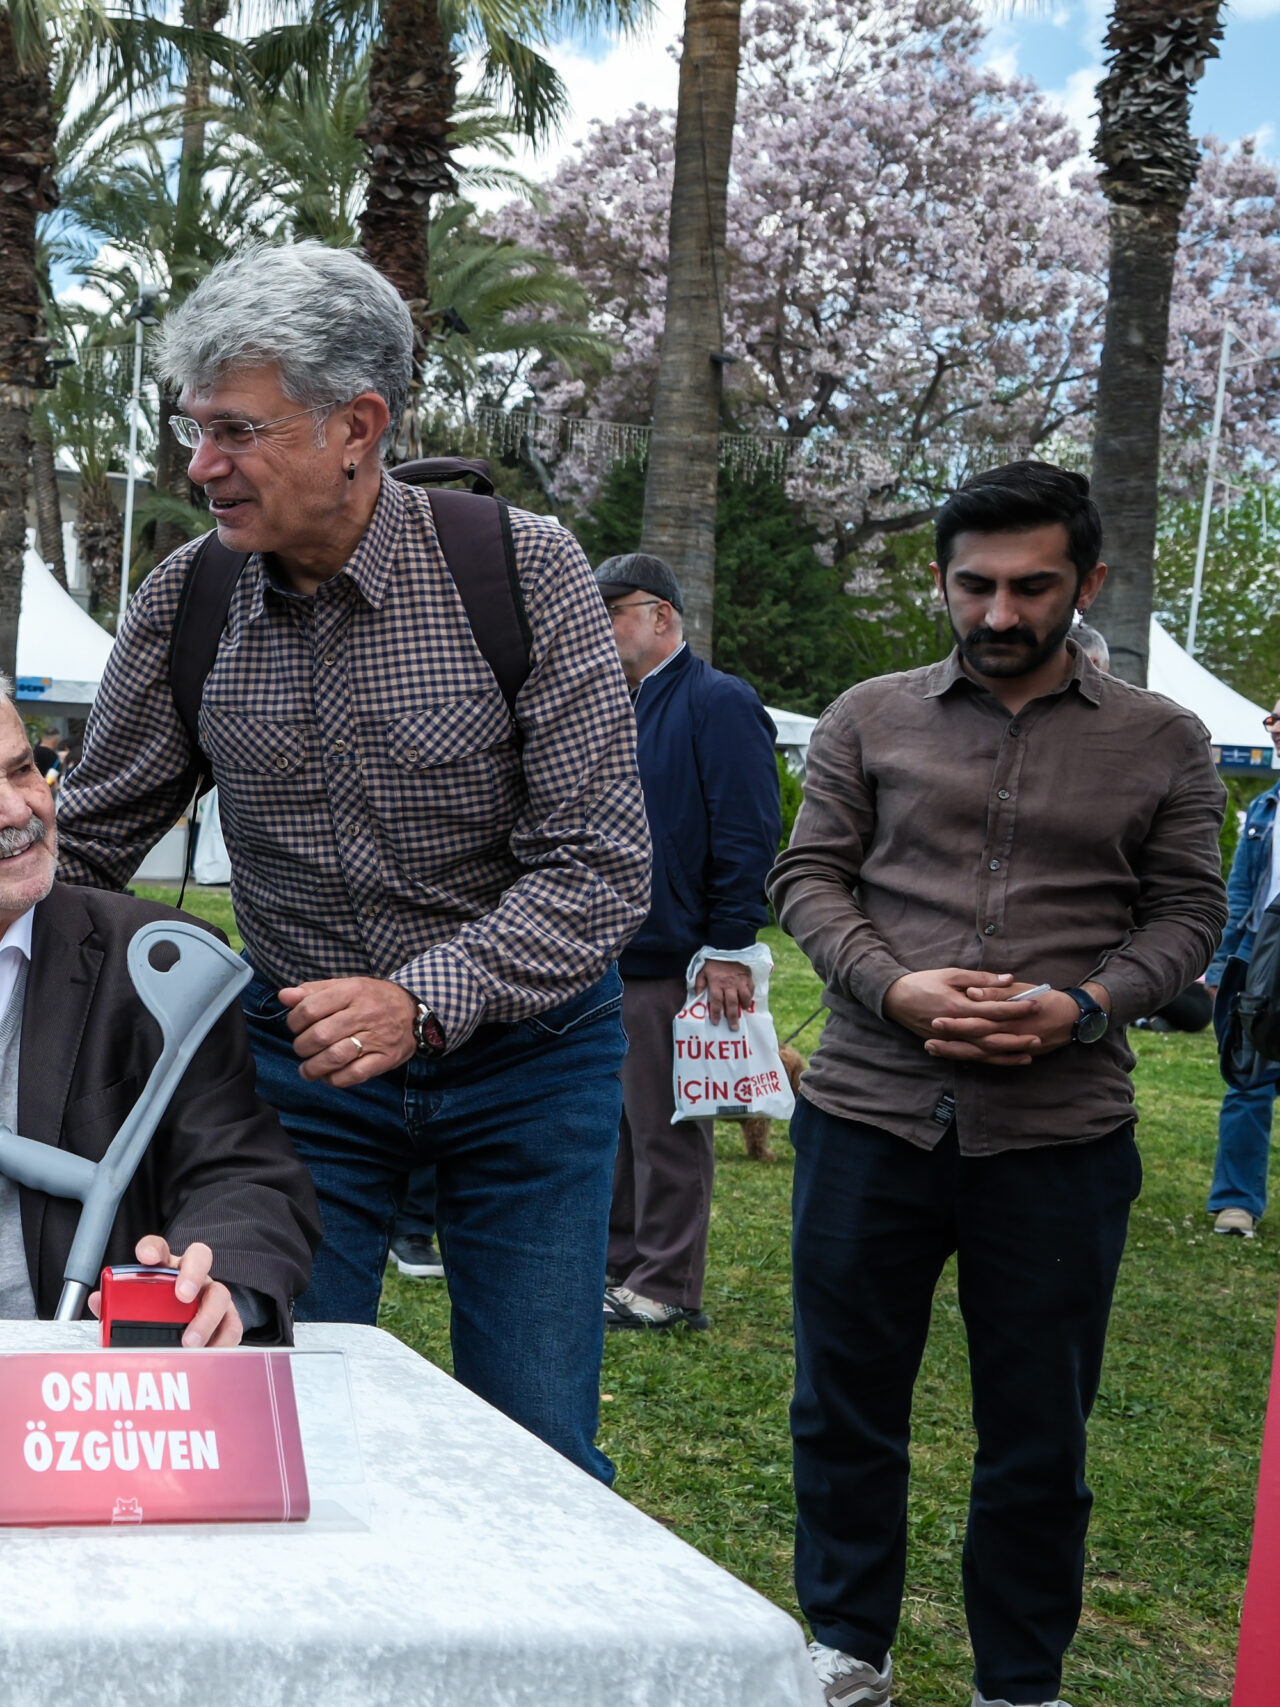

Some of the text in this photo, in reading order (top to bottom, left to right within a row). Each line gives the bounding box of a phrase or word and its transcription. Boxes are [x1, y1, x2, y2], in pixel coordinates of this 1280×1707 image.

[675, 1035, 753, 1060] TÜKETİ
[677, 1075, 729, 1105] İÇİN
[750, 1070, 778, 1087] SIFIR
[755, 1081, 782, 1098] ATIK
[41, 1371, 191, 1412] OSMAN
[23, 1419, 220, 1472] ÖZGÜVEN
